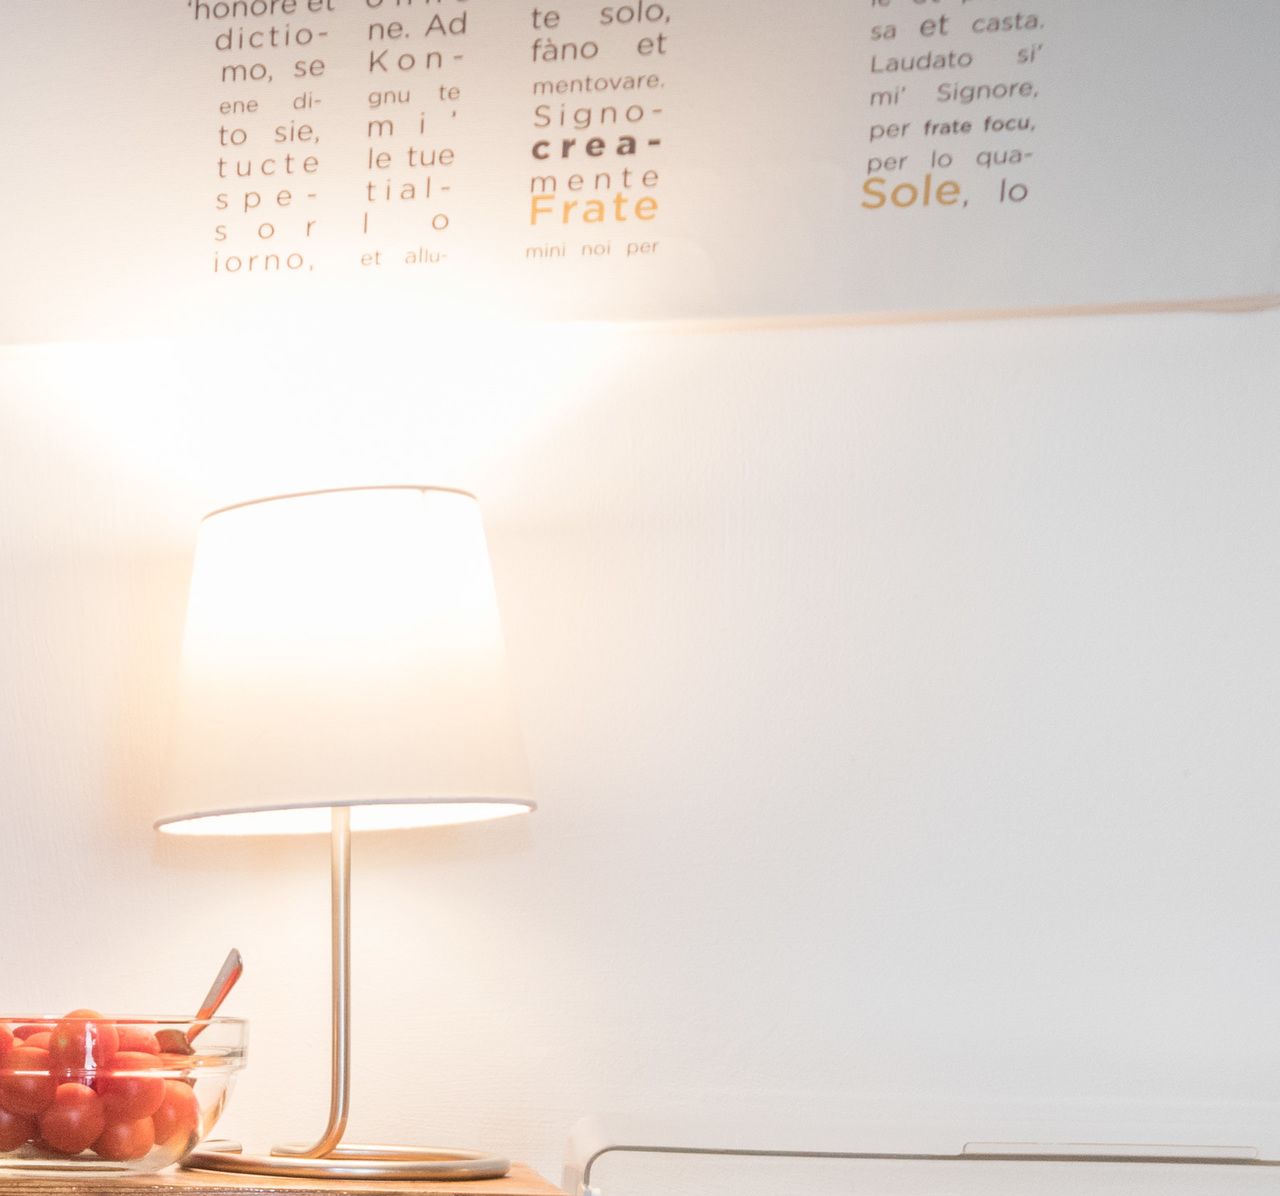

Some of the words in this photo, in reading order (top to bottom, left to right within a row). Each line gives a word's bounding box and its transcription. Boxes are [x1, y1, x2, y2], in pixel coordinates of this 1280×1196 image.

[368, 21, 410, 41] ne.
[424, 10, 468, 37] Ad
[531, 7, 561, 30] te
[870, 24, 897, 42] sa
[919, 14, 949, 37] et
[214, 26, 328, 52] dictio-
[636, 32, 667, 56] et
[221, 63, 273, 83] mo,
[293, 58, 326, 79] se
[870, 50, 974, 74] Laudato
[218, 99, 259, 116] ene
[292, 92, 321, 111] di-
[367, 90, 411, 110] gnu
[438, 84, 461, 102] te
[937, 81, 1039, 105] Signore,
[533, 104, 663, 131] Signo-
[218, 125, 248, 147] to
[274, 123, 320, 144] sie,
[869, 122, 911, 143] per
[923, 119, 973, 136] frate
[367, 147, 392, 170] le
[407, 146, 455, 168] tue
[531, 135, 661, 161] crea-
[217, 153, 320, 179] tucte
[866, 156, 908, 176] per
[930, 149, 954, 169] lo
[975, 149, 1033, 169] qua-
[529, 167, 659, 194] mente
[860, 173, 968, 210] Sole,
[999, 178, 1029, 203] lo
[529, 192, 659, 226] Frate
[359, 250, 382, 267] et
[581, 243, 611, 256] noi
[626, 241, 658, 257] per
